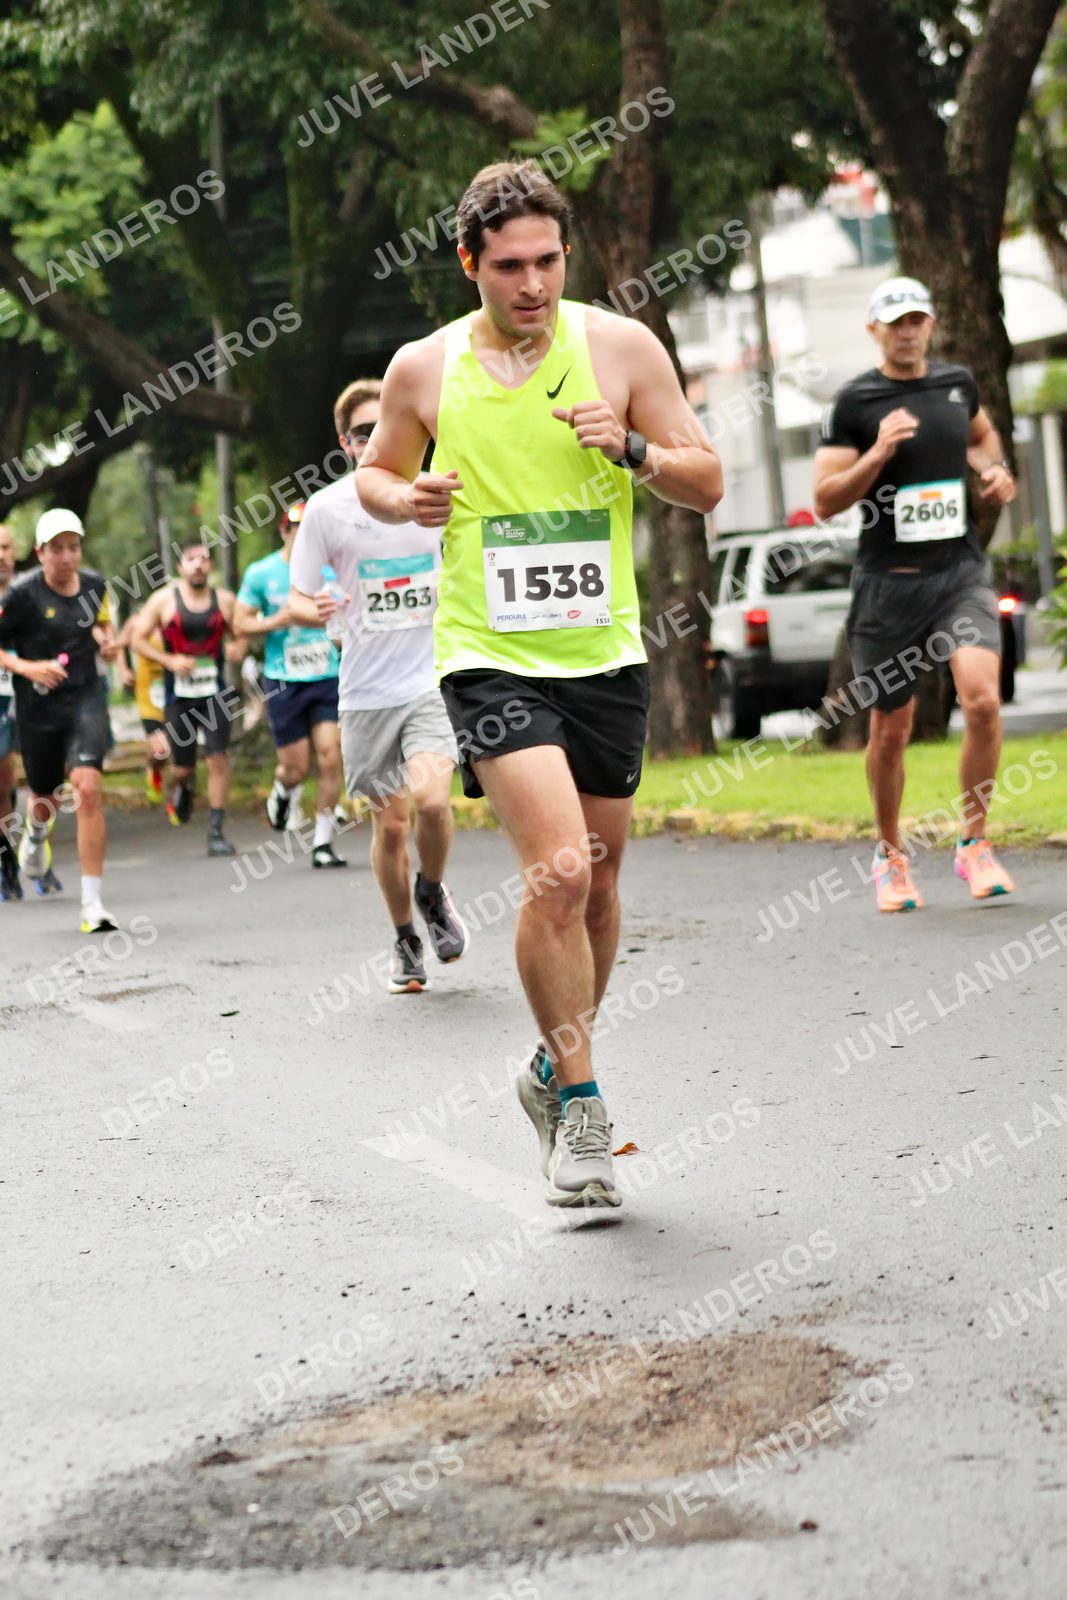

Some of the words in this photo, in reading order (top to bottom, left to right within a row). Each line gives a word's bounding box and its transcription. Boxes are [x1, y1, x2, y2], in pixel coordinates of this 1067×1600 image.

[900, 499, 958, 524] 2606
[497, 562, 604, 603] 1538
[367, 586, 432, 613] 2963
[496, 613, 527, 622] PERDURA
